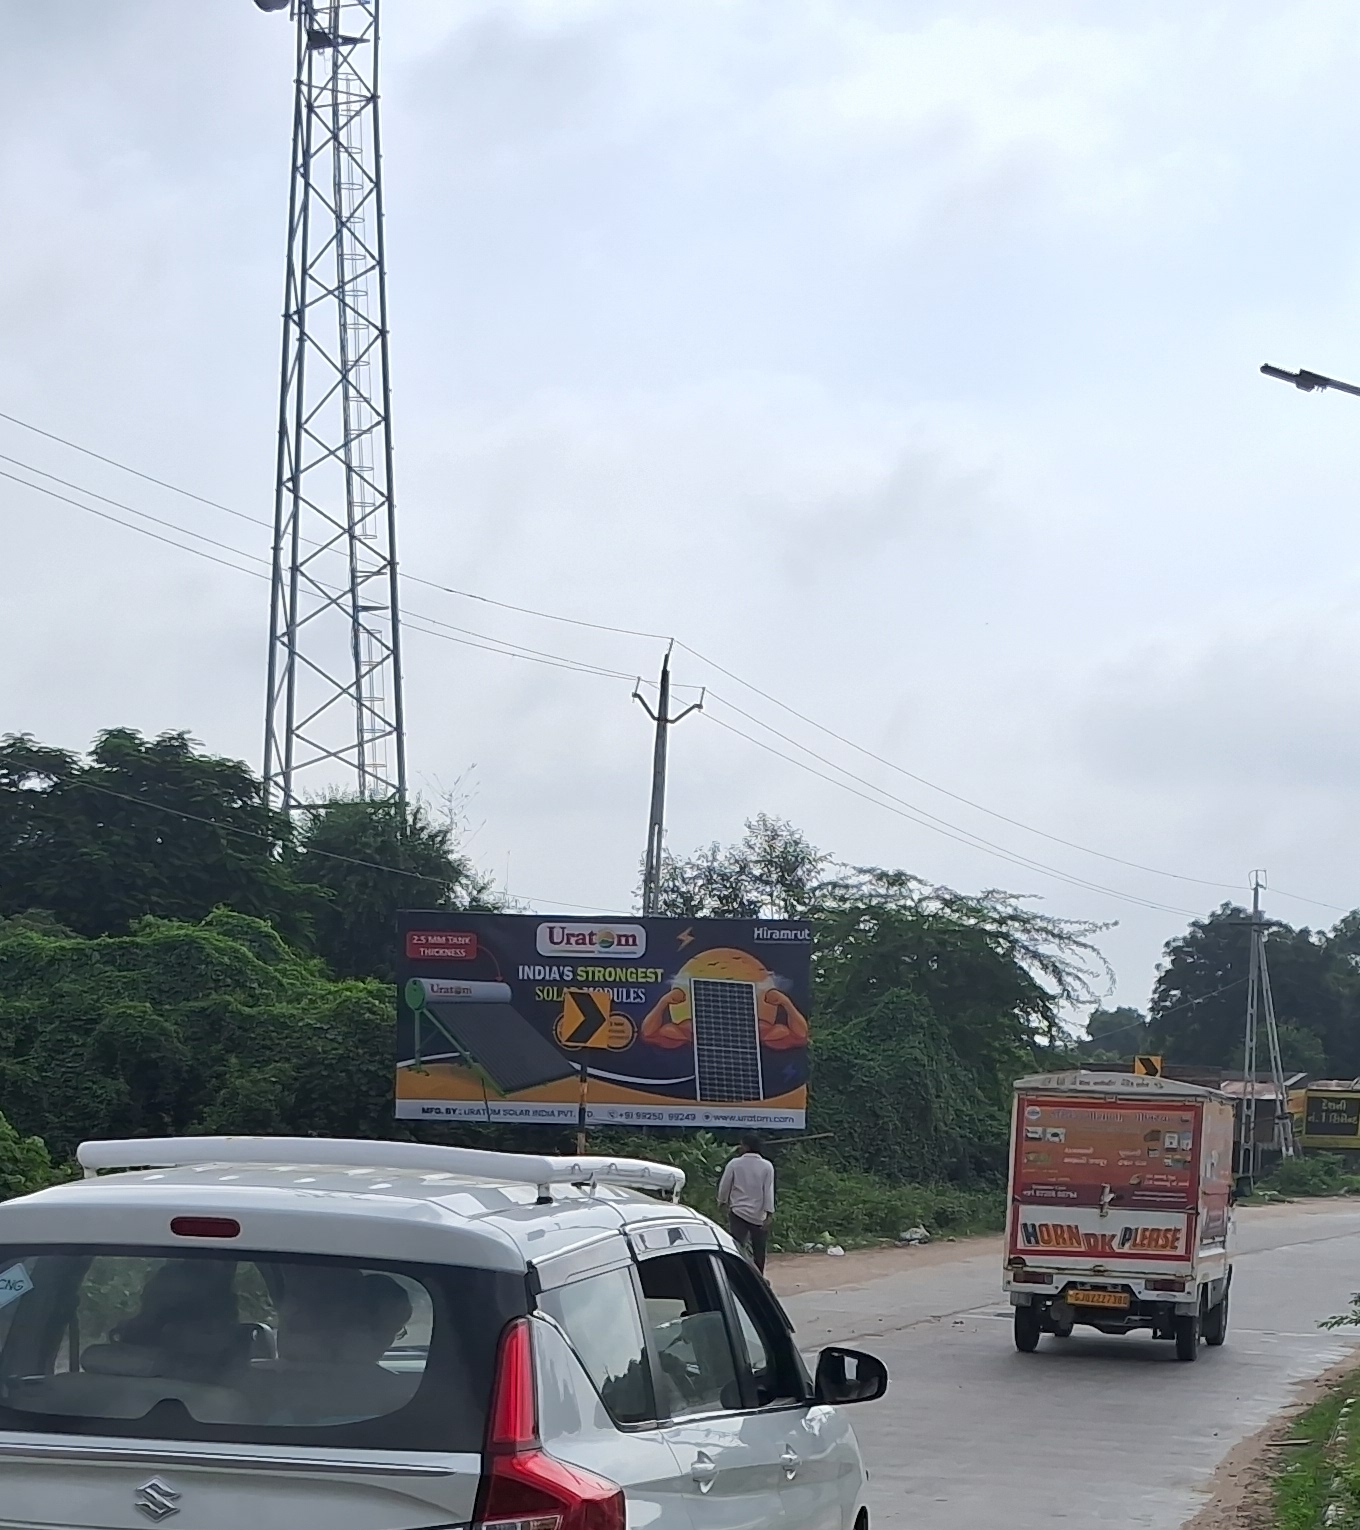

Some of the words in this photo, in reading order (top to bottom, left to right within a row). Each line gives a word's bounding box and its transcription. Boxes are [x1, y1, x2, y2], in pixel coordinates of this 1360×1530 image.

[447, 936, 471, 945] TANK
[547, 926, 638, 949] Uratom
[754, 926, 811, 940] Hiramrut
[419, 948, 466, 957] THICKNESS
[518, 965, 573, 981] INDIA'S
[576, 966, 664, 983] STRONGEST
[1021, 1223, 1083, 1248] HORN
[1117, 1226, 1183, 1250] PLEASE
